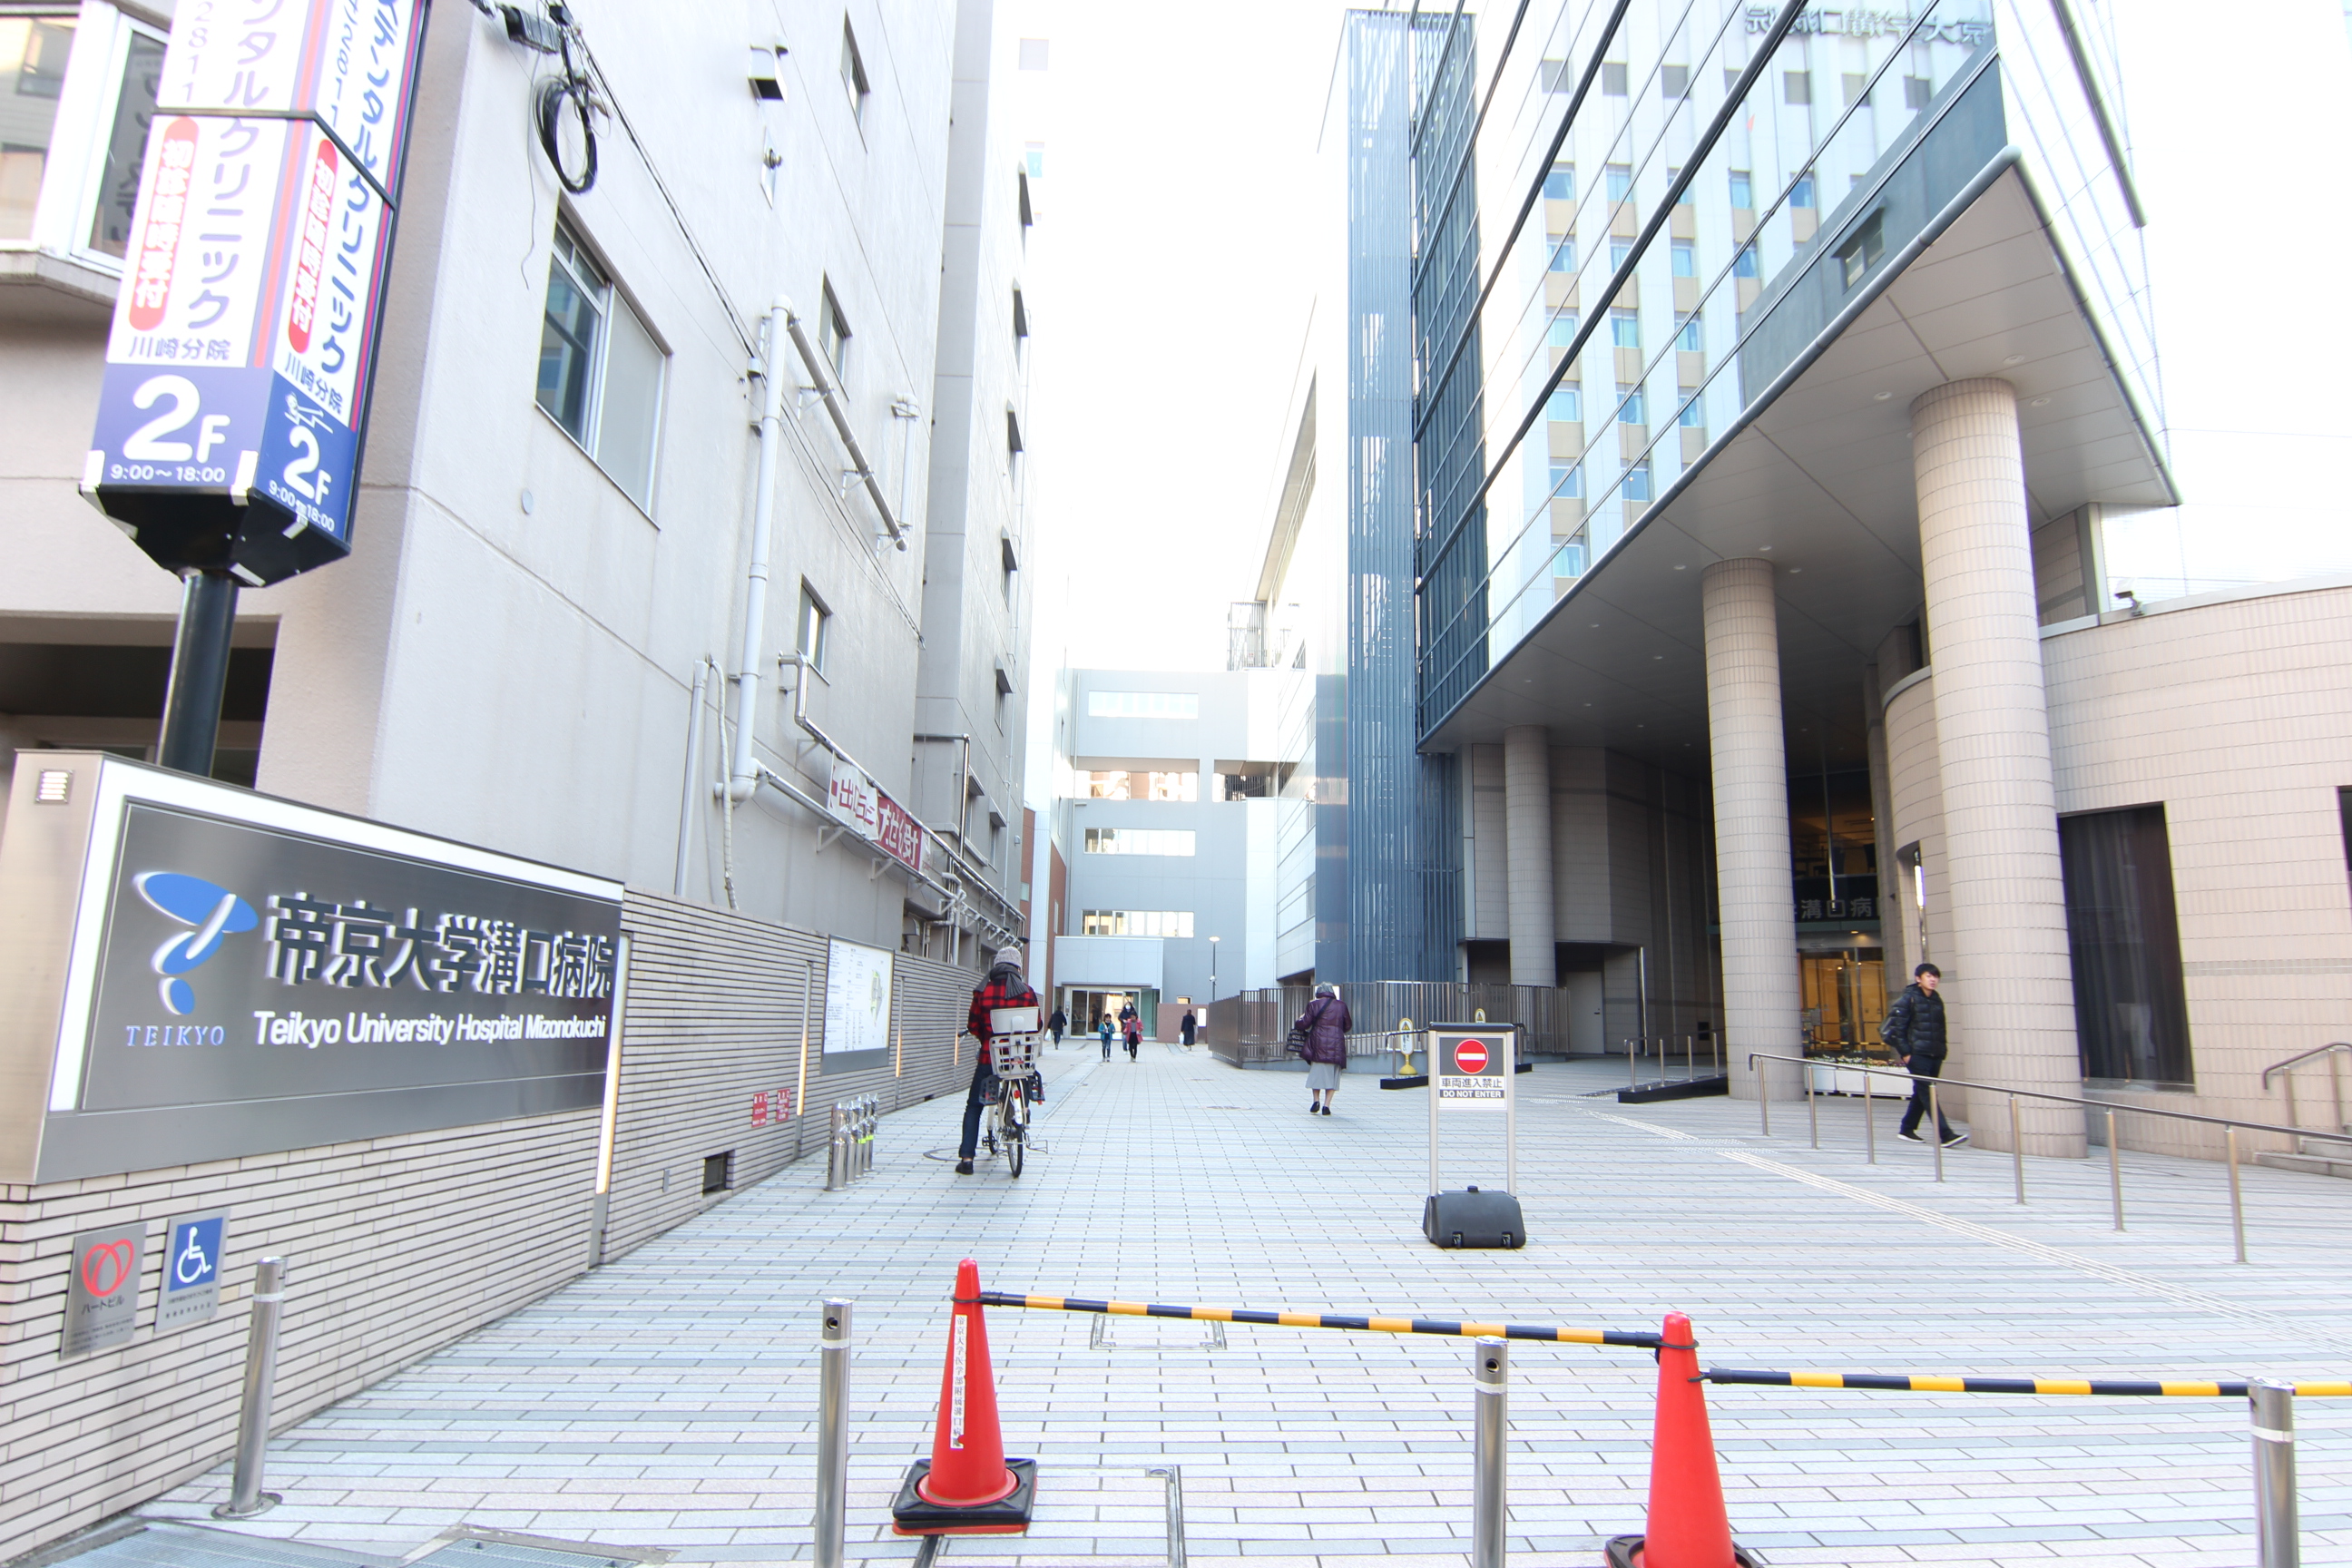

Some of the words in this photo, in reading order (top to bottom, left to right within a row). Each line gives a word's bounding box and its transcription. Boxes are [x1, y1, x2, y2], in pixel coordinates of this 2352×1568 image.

[122, 374, 231, 464] 2F
[283, 425, 333, 505] 2F
[1793, 897, 1880, 919] 溝口病
[264, 891, 617, 998] 帝京大学溝口病院
[126, 1025, 225, 1047] TEIKYO
[253, 1010, 342, 1049] Teikyo
[346, 1012, 455, 1045] University
[456, 1013, 524, 1043] Hospital
[524, 1014, 607, 1040] Mizonokuchi
[1441, 1077, 1503, 1089] 車両進入禁止
[1443, 1090, 1455, 1098] DO
[1456, 1090, 1474, 1098] NOT
[1475, 1090, 1502, 1098] ENTER
